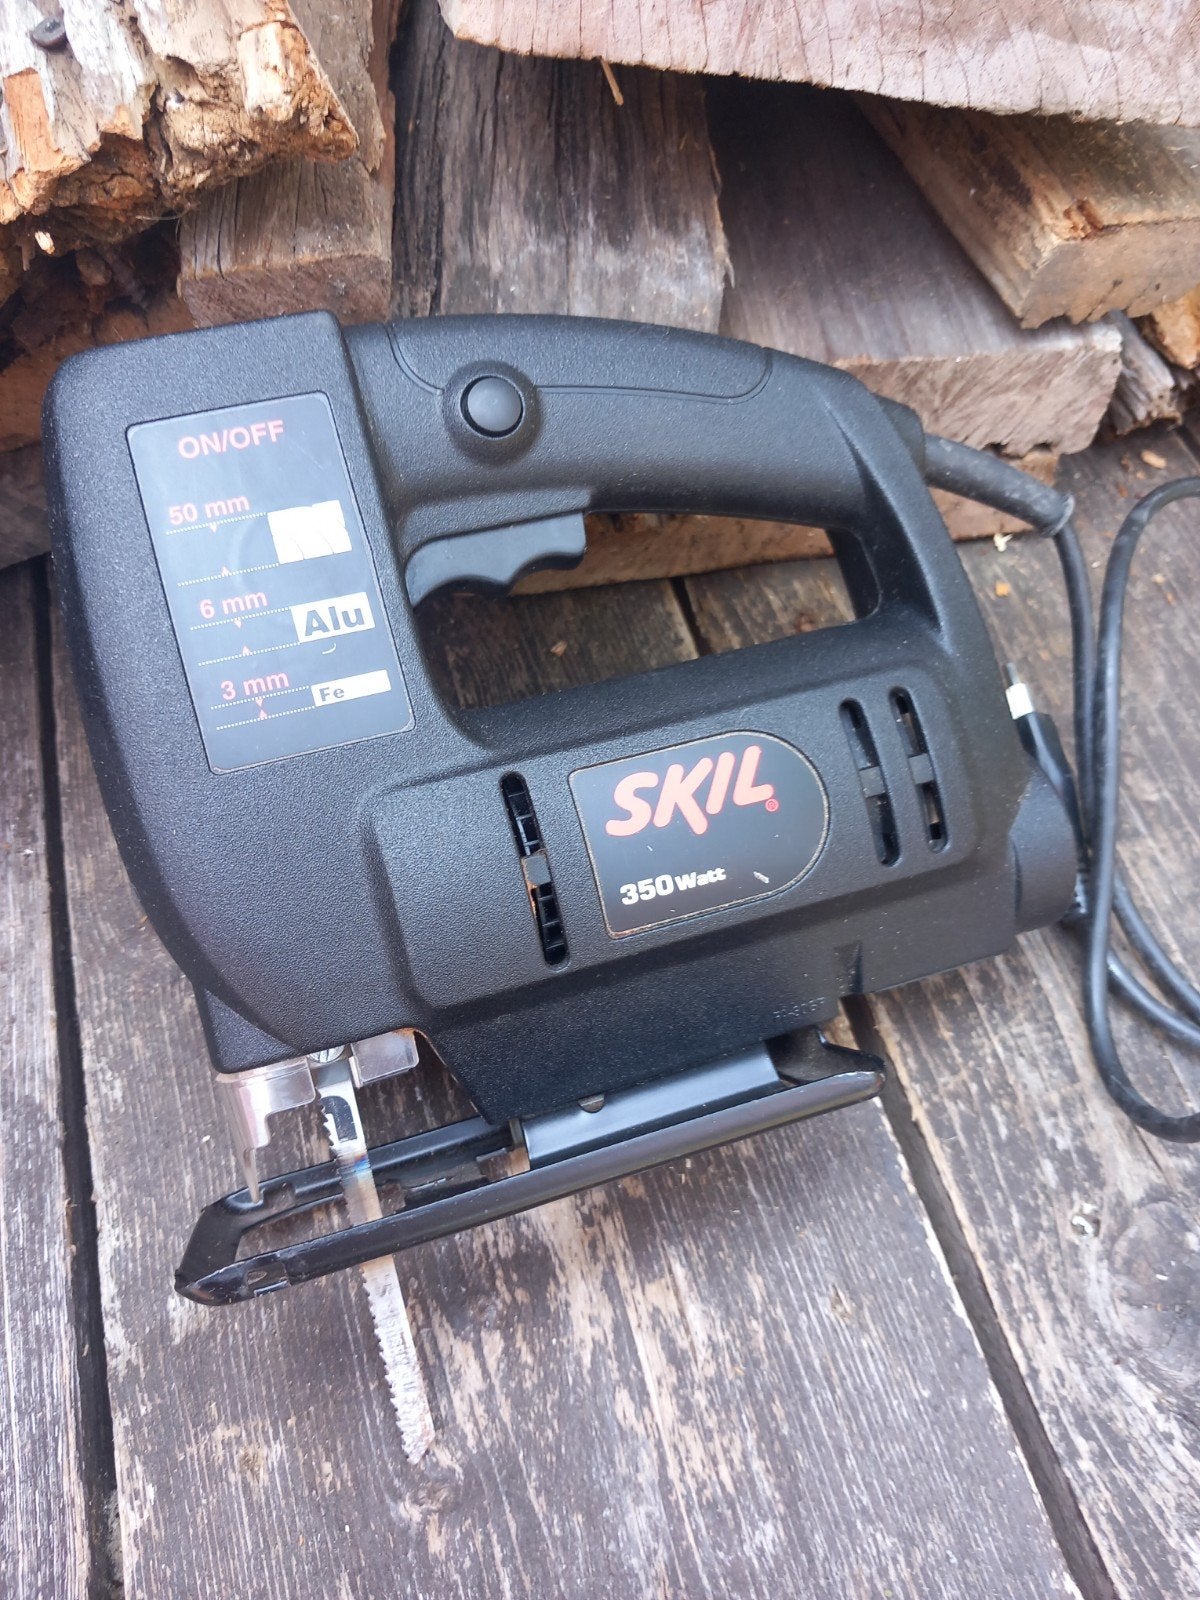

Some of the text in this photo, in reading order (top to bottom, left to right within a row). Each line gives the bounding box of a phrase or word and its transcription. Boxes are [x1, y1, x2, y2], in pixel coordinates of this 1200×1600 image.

[177, 420, 284, 459] ON/OFF
[168, 495, 250, 525] 50 mm
[199, 591, 268, 619] 6 mm
[304, 606, 365, 636] Alu
[220, 672, 290, 700] 3 mm
[319, 687, 345, 702] Fe
[605, 745, 774, 837] SKIL
